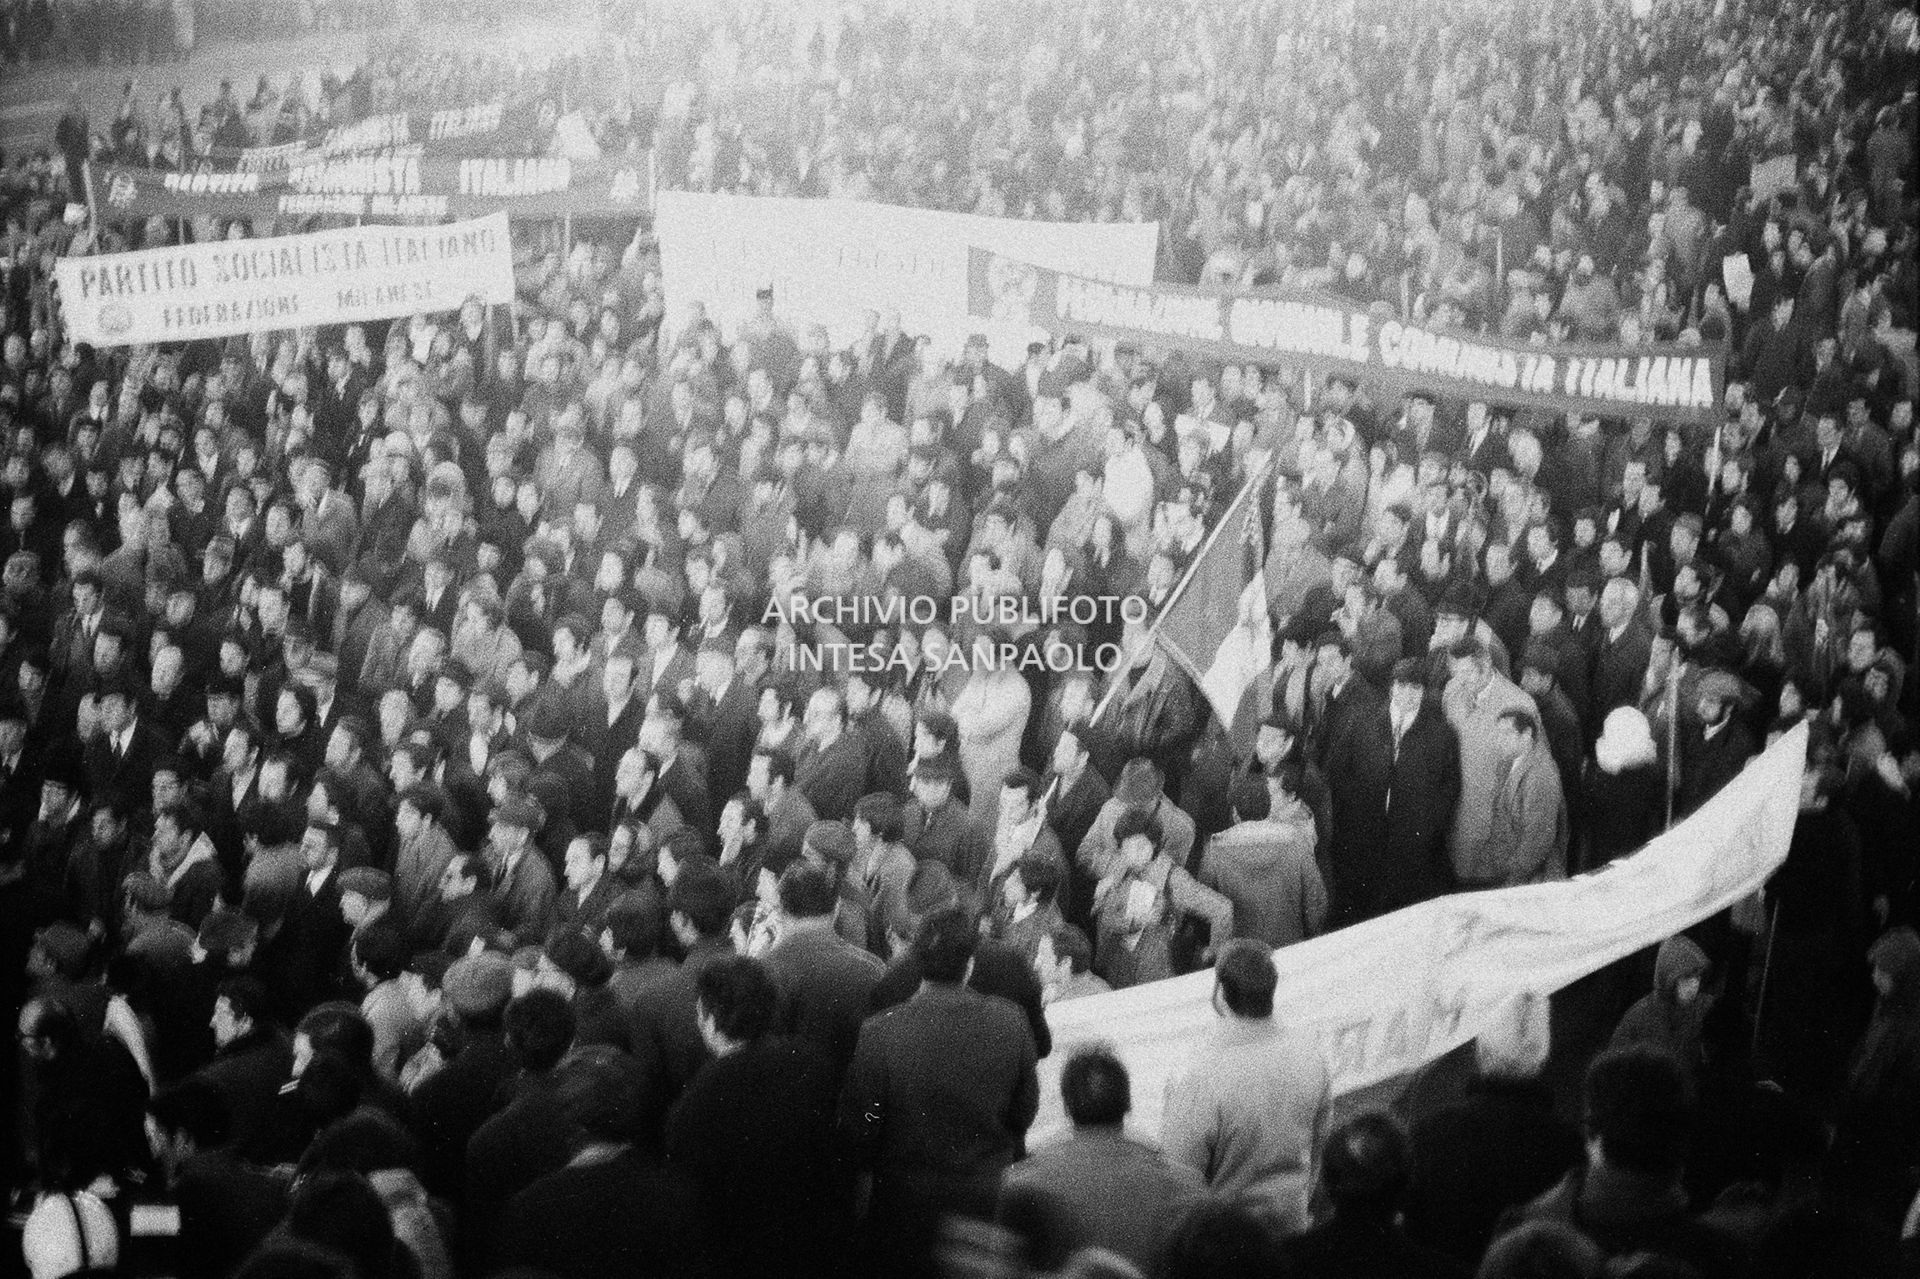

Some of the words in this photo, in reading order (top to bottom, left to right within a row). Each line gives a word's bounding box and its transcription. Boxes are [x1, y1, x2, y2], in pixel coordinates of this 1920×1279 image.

[459, 157, 571, 197] ITALIANO
[80, 258, 198, 299] PARTITO
[212, 240, 369, 283] SOCIALISTA
[384, 229, 496, 267] ITALIANO
[162, 294, 300, 328] FEDERAZIONE
[1379, 320, 1555, 393] COMUNISTA
[1565, 355, 1713, 408] ITALIANA
